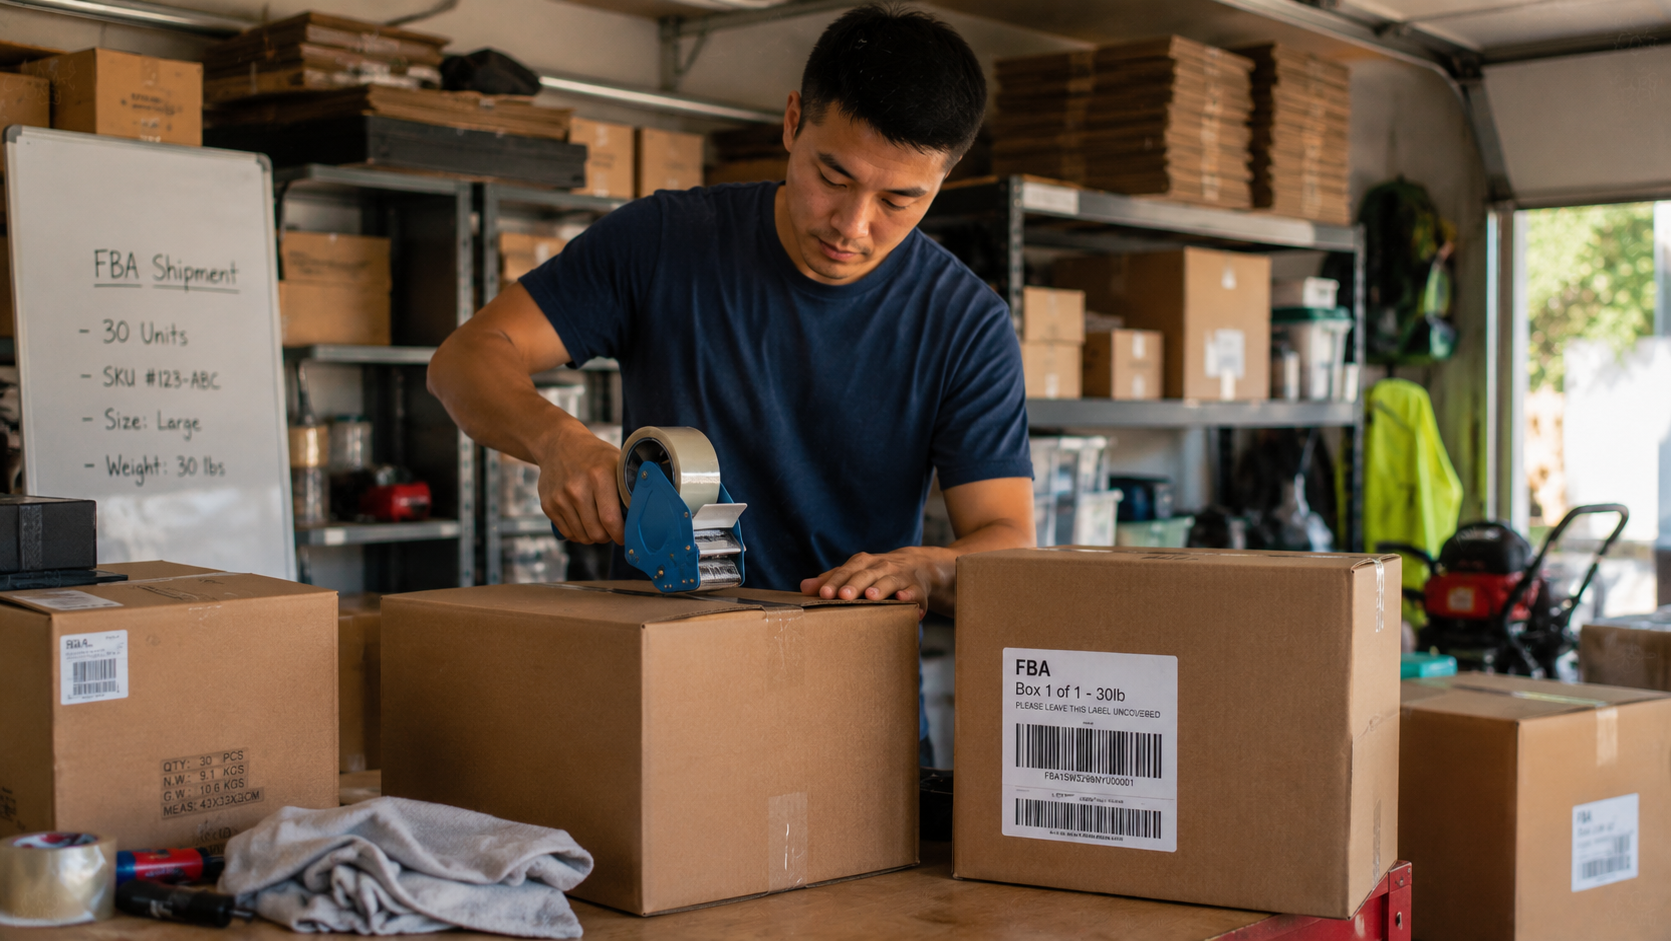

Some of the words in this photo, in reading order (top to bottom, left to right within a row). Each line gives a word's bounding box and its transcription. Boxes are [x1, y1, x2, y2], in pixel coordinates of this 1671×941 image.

[94, 249, 139, 279] FBA
[152, 253, 239, 293] Shipment
[103, 318, 130, 344] 30
[140, 321, 188, 346] Units
[103, 365, 135, 388] SKU
[145, 368, 221, 390] #123-ABC
[104, 407, 147, 430] Size:
[157, 409, 202, 442] Large
[106, 454, 167, 487] Weight:
[176, 455, 198, 478] 30
[203, 455, 226, 477] lbs
[1015, 658, 1051, 677] FBA
[1015, 682, 1041, 697] Box
[1046, 684, 1051, 697] 1
[1057, 685, 1071, 698] of
[1074, 686, 1080, 699] 1
[1096, 687, 1126, 702] 30lb
[1015, 702, 1043, 710] PLEASE
[1045, 703, 1068, 712] LEAVE
[1070, 705, 1086, 713] THIS
[1088, 706, 1111, 715] LABEL
[163, 759, 190, 772] QTY:
[200, 756, 212, 766] 30
[223, 750, 244, 762] PCS
[200, 769, 215, 781] 9.1
[223, 778, 245, 790] KGS
[163, 802, 197, 816] MEAS:
